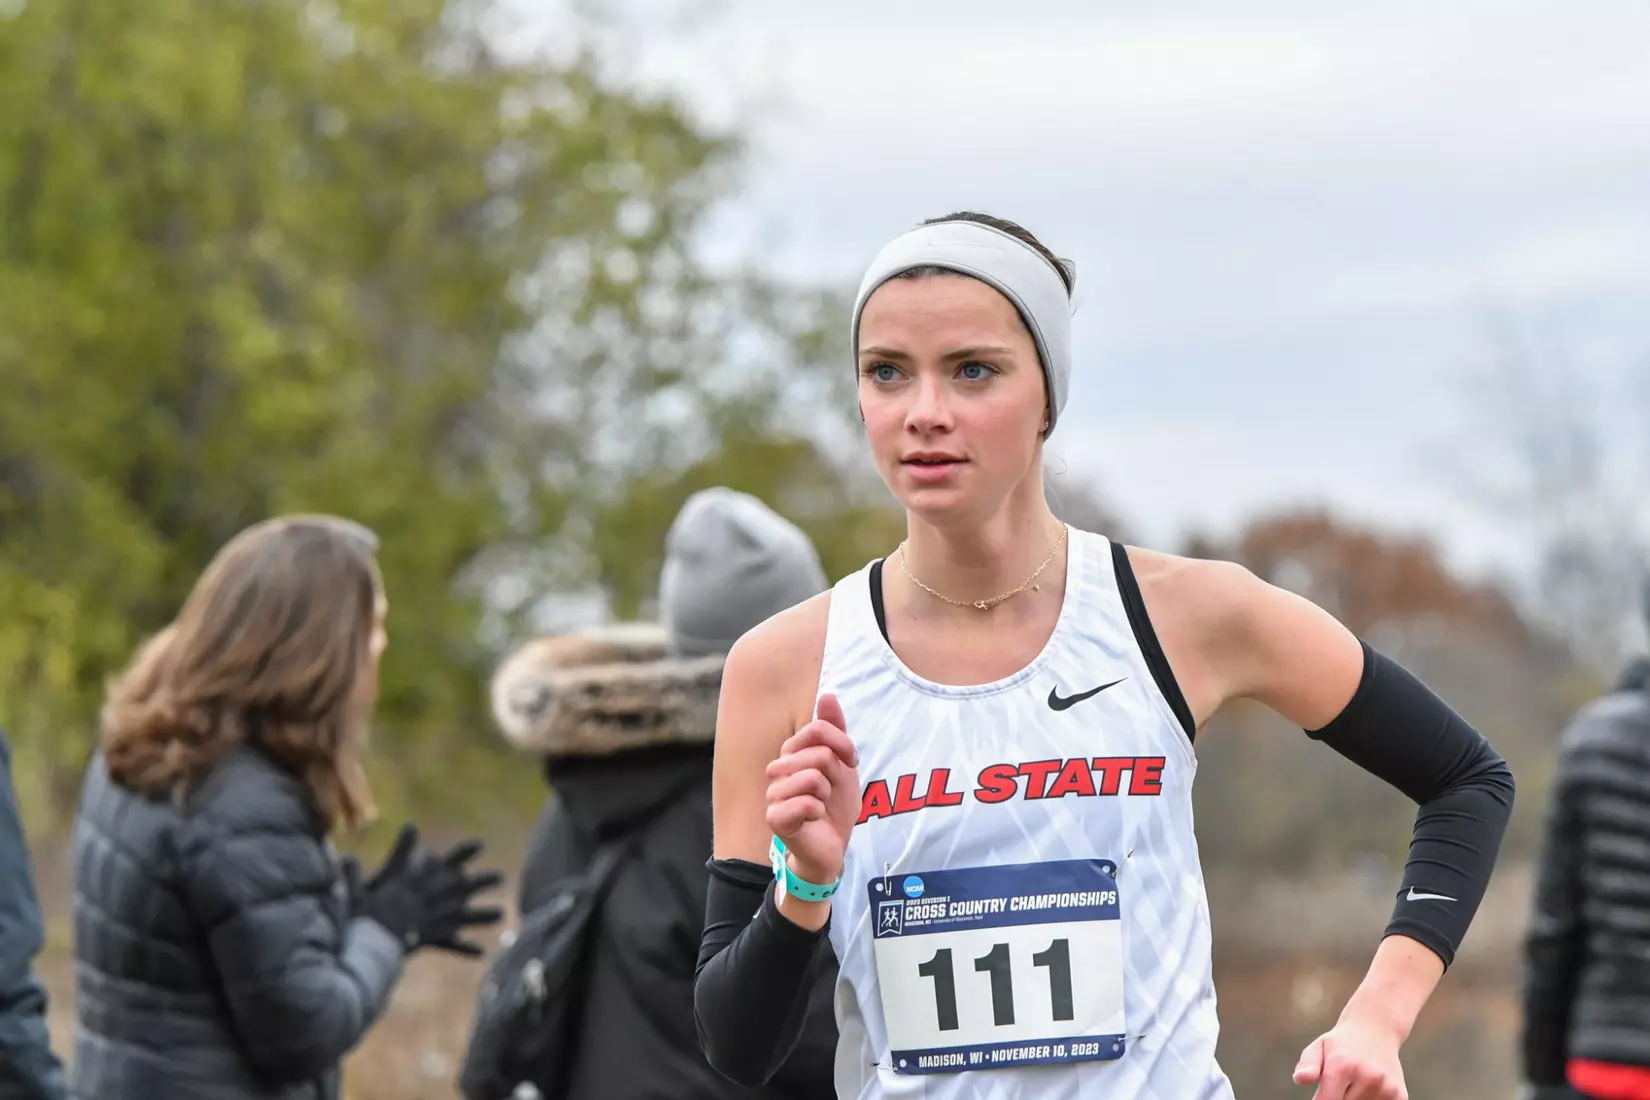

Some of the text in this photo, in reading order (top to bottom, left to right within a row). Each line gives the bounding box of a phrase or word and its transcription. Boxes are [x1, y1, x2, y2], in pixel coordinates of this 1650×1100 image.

[854, 756, 1166, 826] ALL STATE
[905, 890, 1117, 920] CROSS COUNTRY CHAMPIONSHIPS
[921, 896, 946, 904] DIVISION
[918, 938, 1074, 1031] 111
[918, 1043, 1099, 1068] MADISON, WI NOVEMBER 10, 2023
